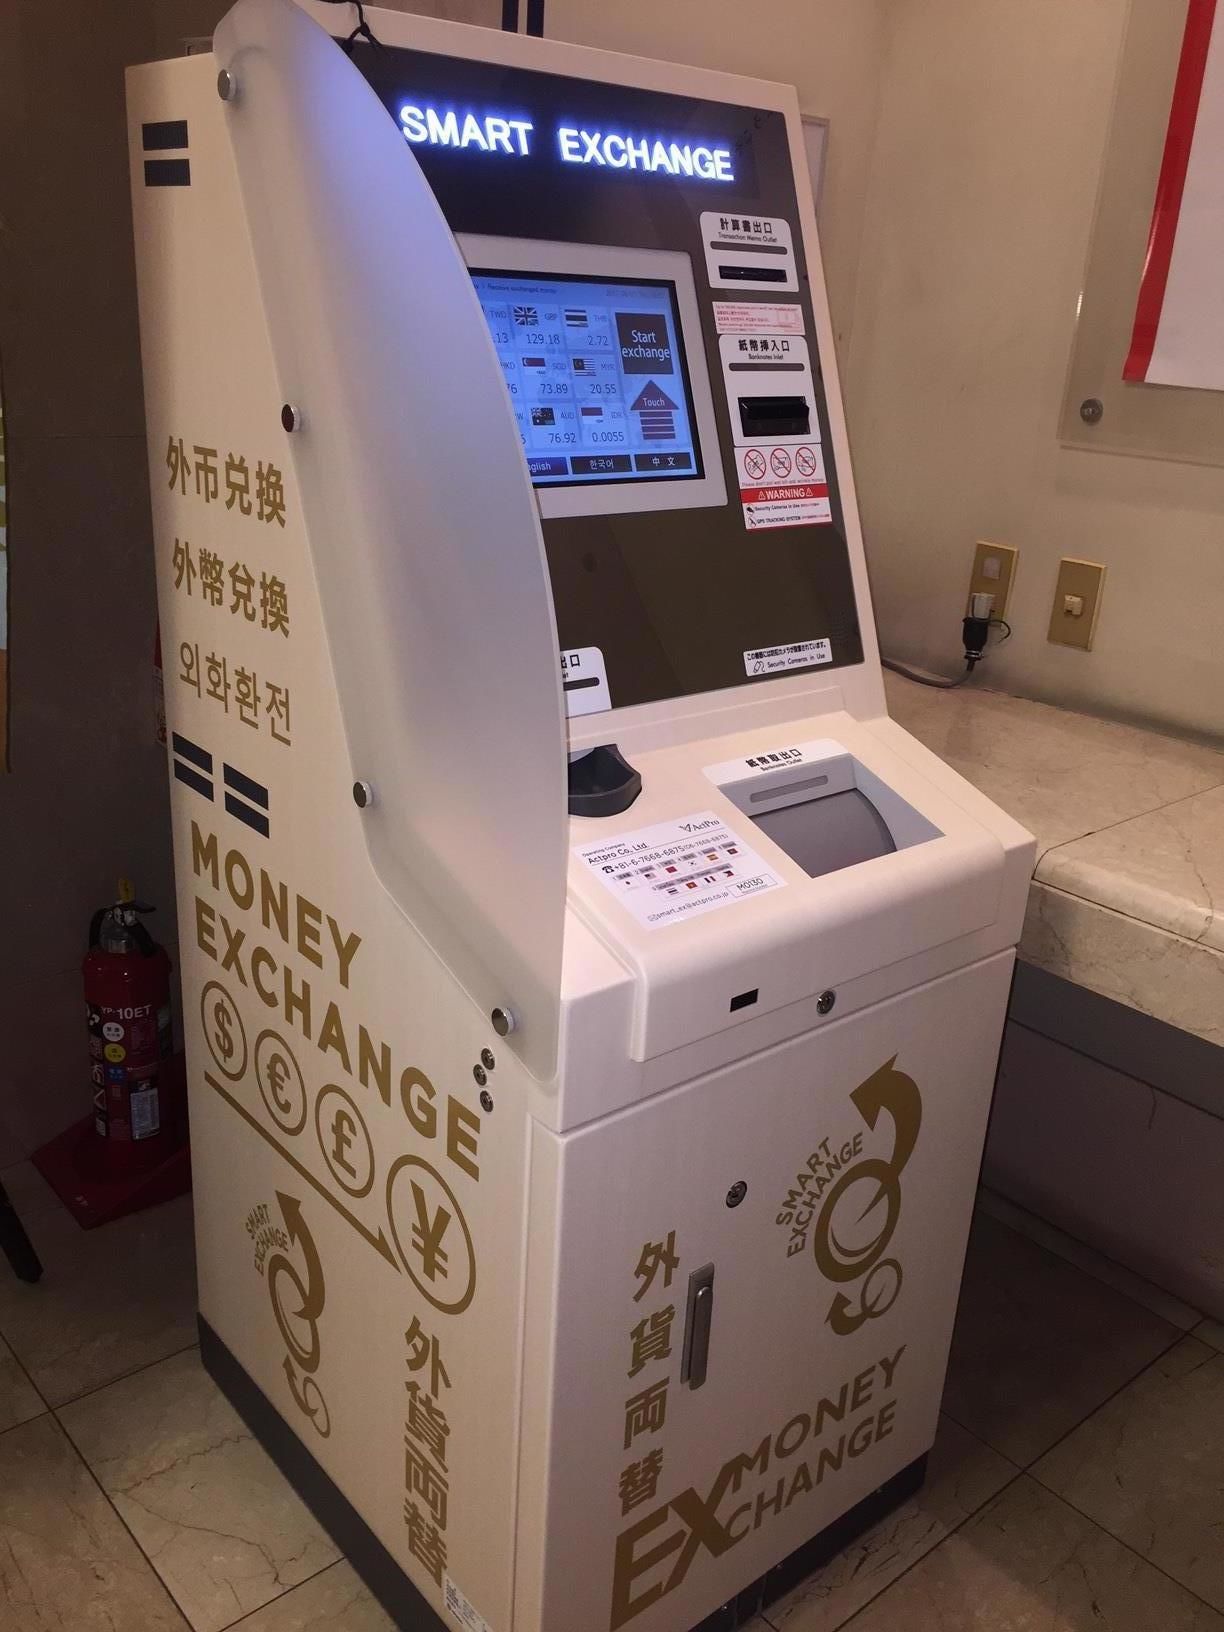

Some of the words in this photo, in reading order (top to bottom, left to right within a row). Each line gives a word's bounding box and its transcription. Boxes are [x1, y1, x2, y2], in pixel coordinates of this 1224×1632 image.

[400, 105, 533, 156] SMART
[558, 127, 735, 182] EXCHANGE
[526, 333, 561, 345] 129.18
[587, 335, 609, 346] 2.72
[631, 330, 656, 343] Start
[621, 345, 671, 361] exchange
[540, 383, 568, 394] 73.89
[590, 384, 617, 395] 20.55
[643, 397, 665, 407] Touch
[548, 432, 577, 444] 76.92
[592, 431, 625, 443] 0.0055
[589, 459, 614, 470] 한국어
[765, 487, 805, 500] WARNING
[179, 641, 292, 747] 외화환전
[588, 852, 617, 865] Actpro
[191, 819, 362, 990] MONEY
[195, 895, 481, 1183] EXCHANGE
[775, 1136, 830, 1225] SMART
[786, 1131, 863, 1258] EXCHANGE
[245, 1203, 270, 1240] SMART
[254, 1227, 289, 1277] EXCHANGE
[617, 1229, 681, 1518] 外貨両替
[722, 1344, 907, 1494] MONEY
[404, 1314, 452, 1588] 外貨両替
